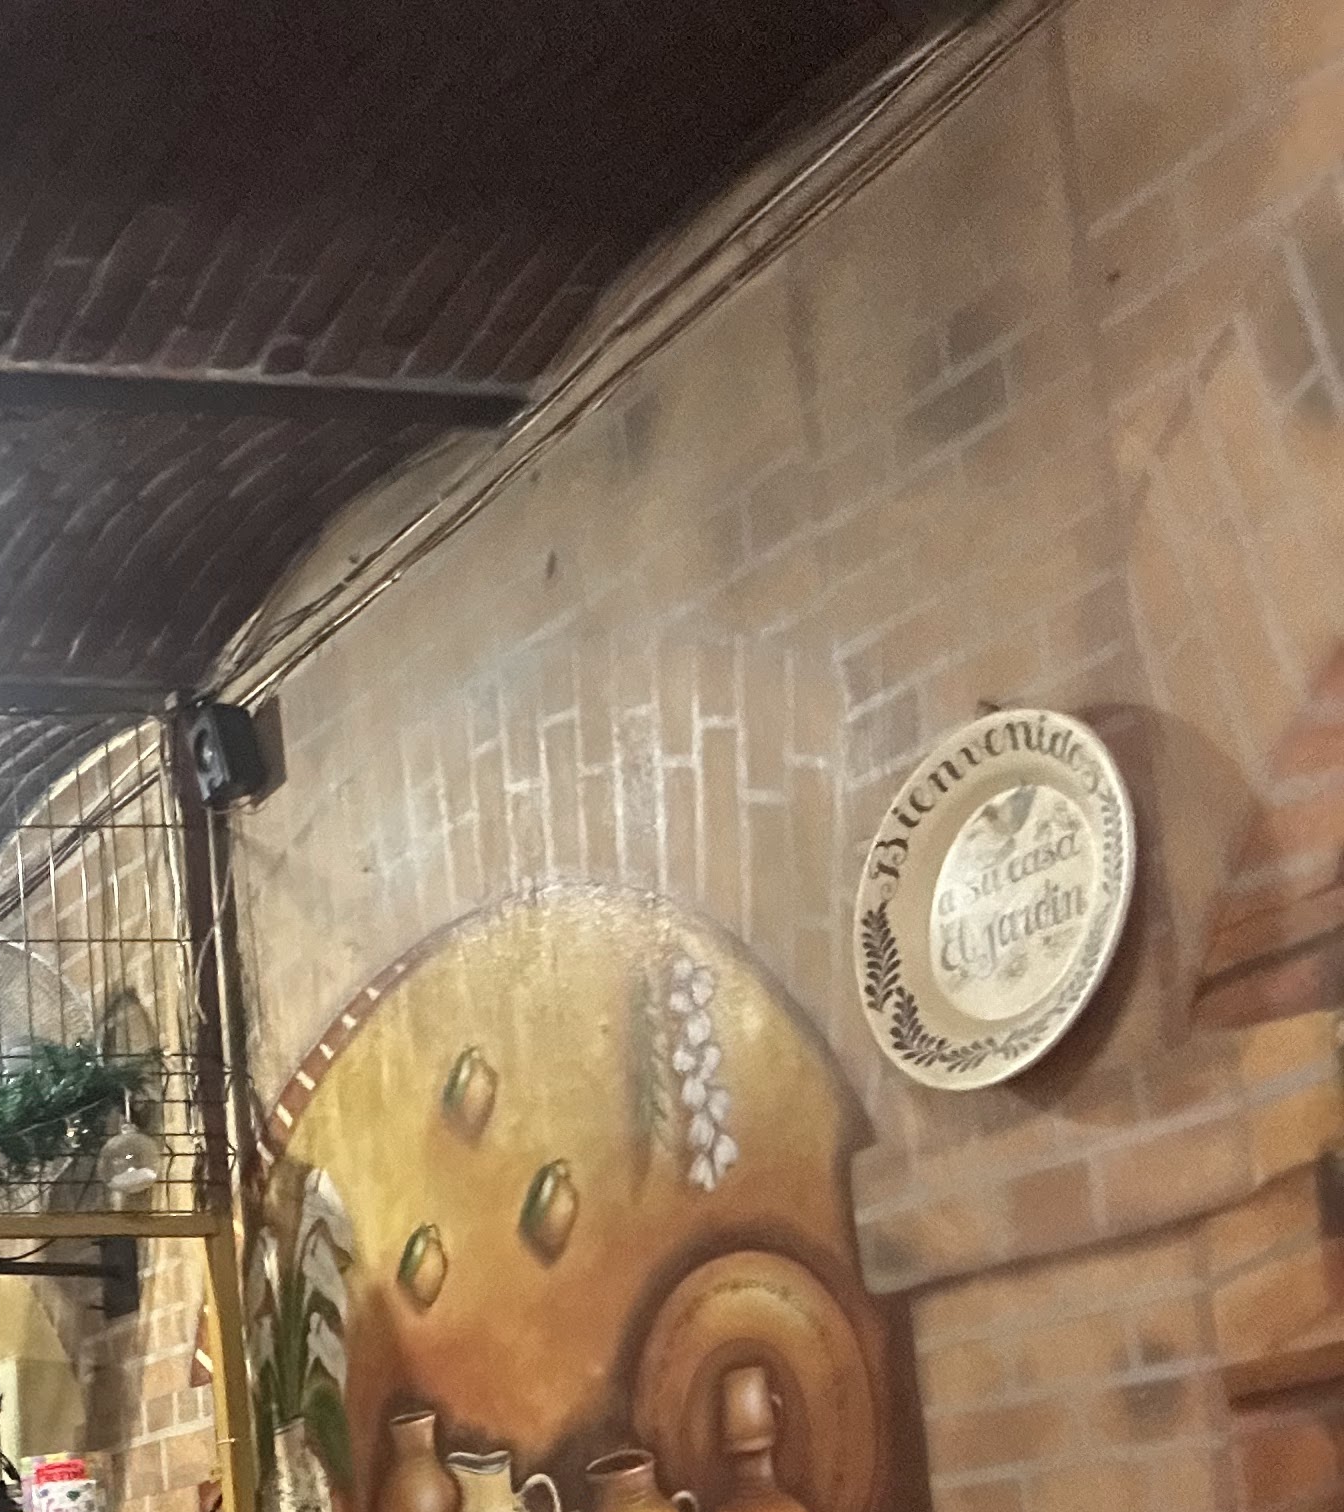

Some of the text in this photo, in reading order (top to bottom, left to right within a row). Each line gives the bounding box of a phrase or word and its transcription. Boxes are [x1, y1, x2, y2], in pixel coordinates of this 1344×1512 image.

[937, 832, 1081, 917] a su casa
